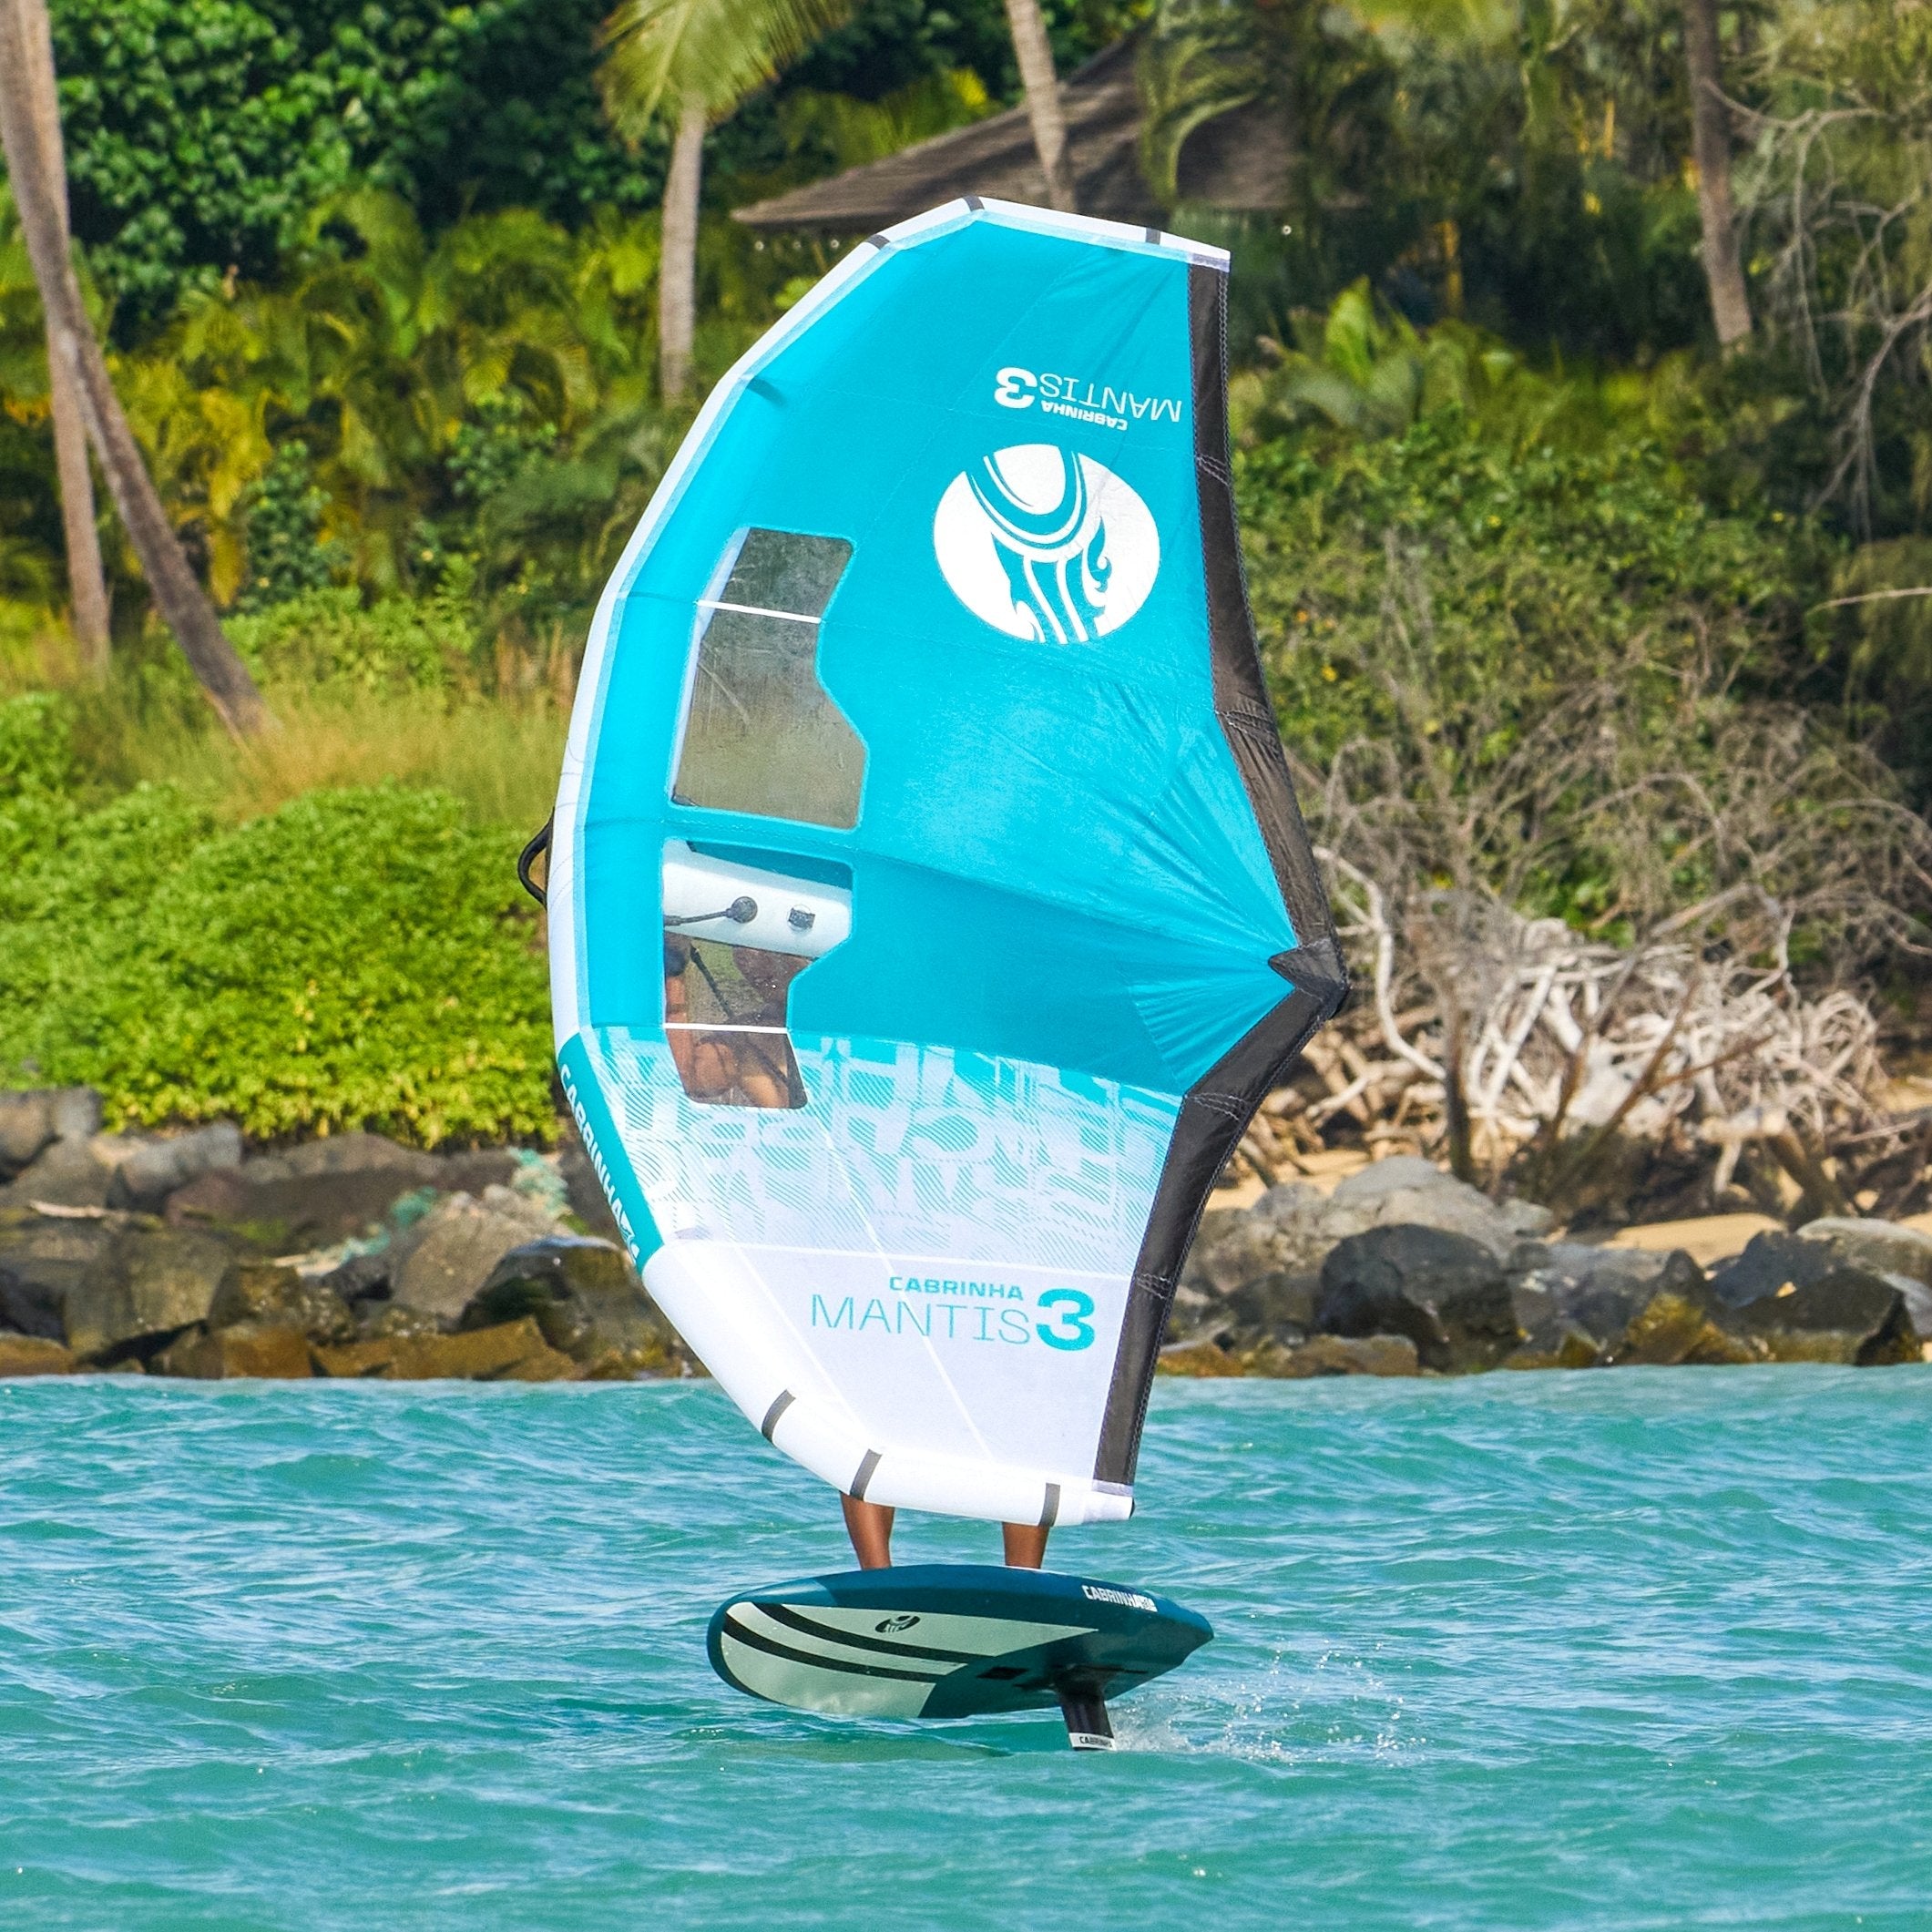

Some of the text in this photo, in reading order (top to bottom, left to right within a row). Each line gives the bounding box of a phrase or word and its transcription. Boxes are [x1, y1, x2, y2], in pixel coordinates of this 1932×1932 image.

[994, 366, 1182, 423] MANTIS 3
[1040, 400, 1129, 431] CABRINHA
[889, 1276, 1024, 1301] CABRINHA
[812, 1288, 1096, 1351] MANTIS 3
